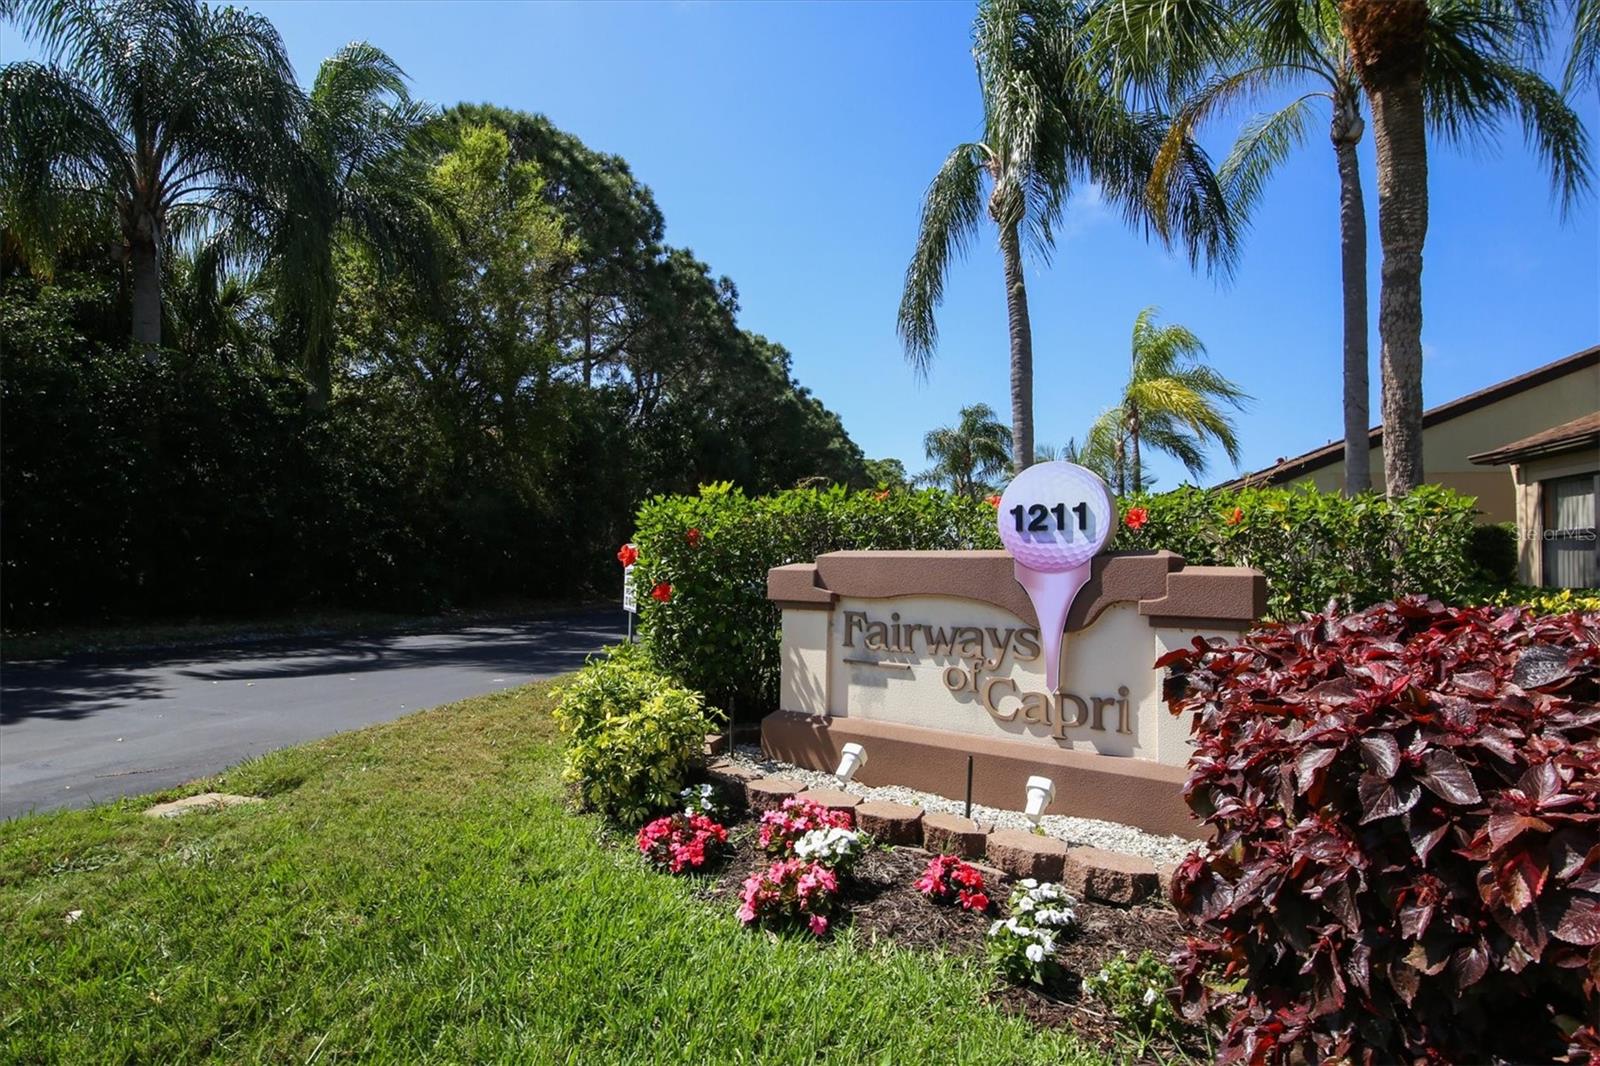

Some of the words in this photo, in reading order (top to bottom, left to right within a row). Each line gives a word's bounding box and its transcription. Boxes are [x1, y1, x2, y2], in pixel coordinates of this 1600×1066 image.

[1010, 502, 1087, 532] 1211
[843, 611, 1041, 671] Fairways
[943, 659, 984, 693] of
[981, 676, 1132, 740] Capri
